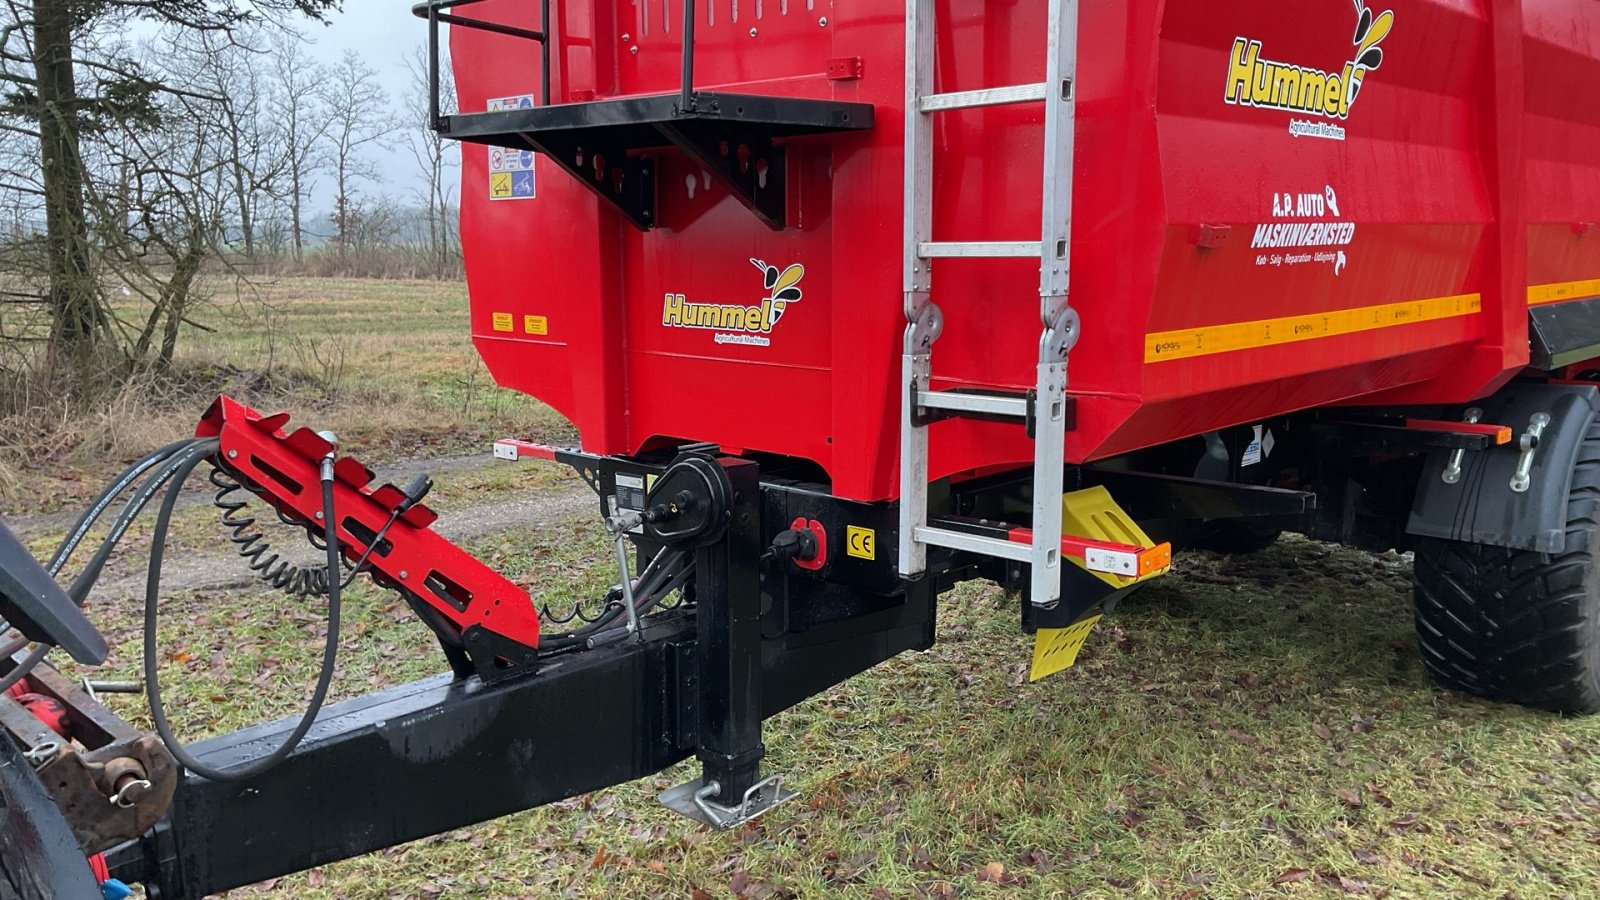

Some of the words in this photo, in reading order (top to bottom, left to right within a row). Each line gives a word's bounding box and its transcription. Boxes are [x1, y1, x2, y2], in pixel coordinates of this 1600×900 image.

[1225, 38, 1349, 118] Hummel
[1290, 120, 1320, 136] Agricultural
[1321, 123, 1345, 138] Machines
[1272, 193, 1294, 217] A.P.
[1297, 193, 1325, 217] AUTO
[1250, 222, 1355, 249] MASKINVÆRKSTED
[663, 294, 772, 333] Hummel
